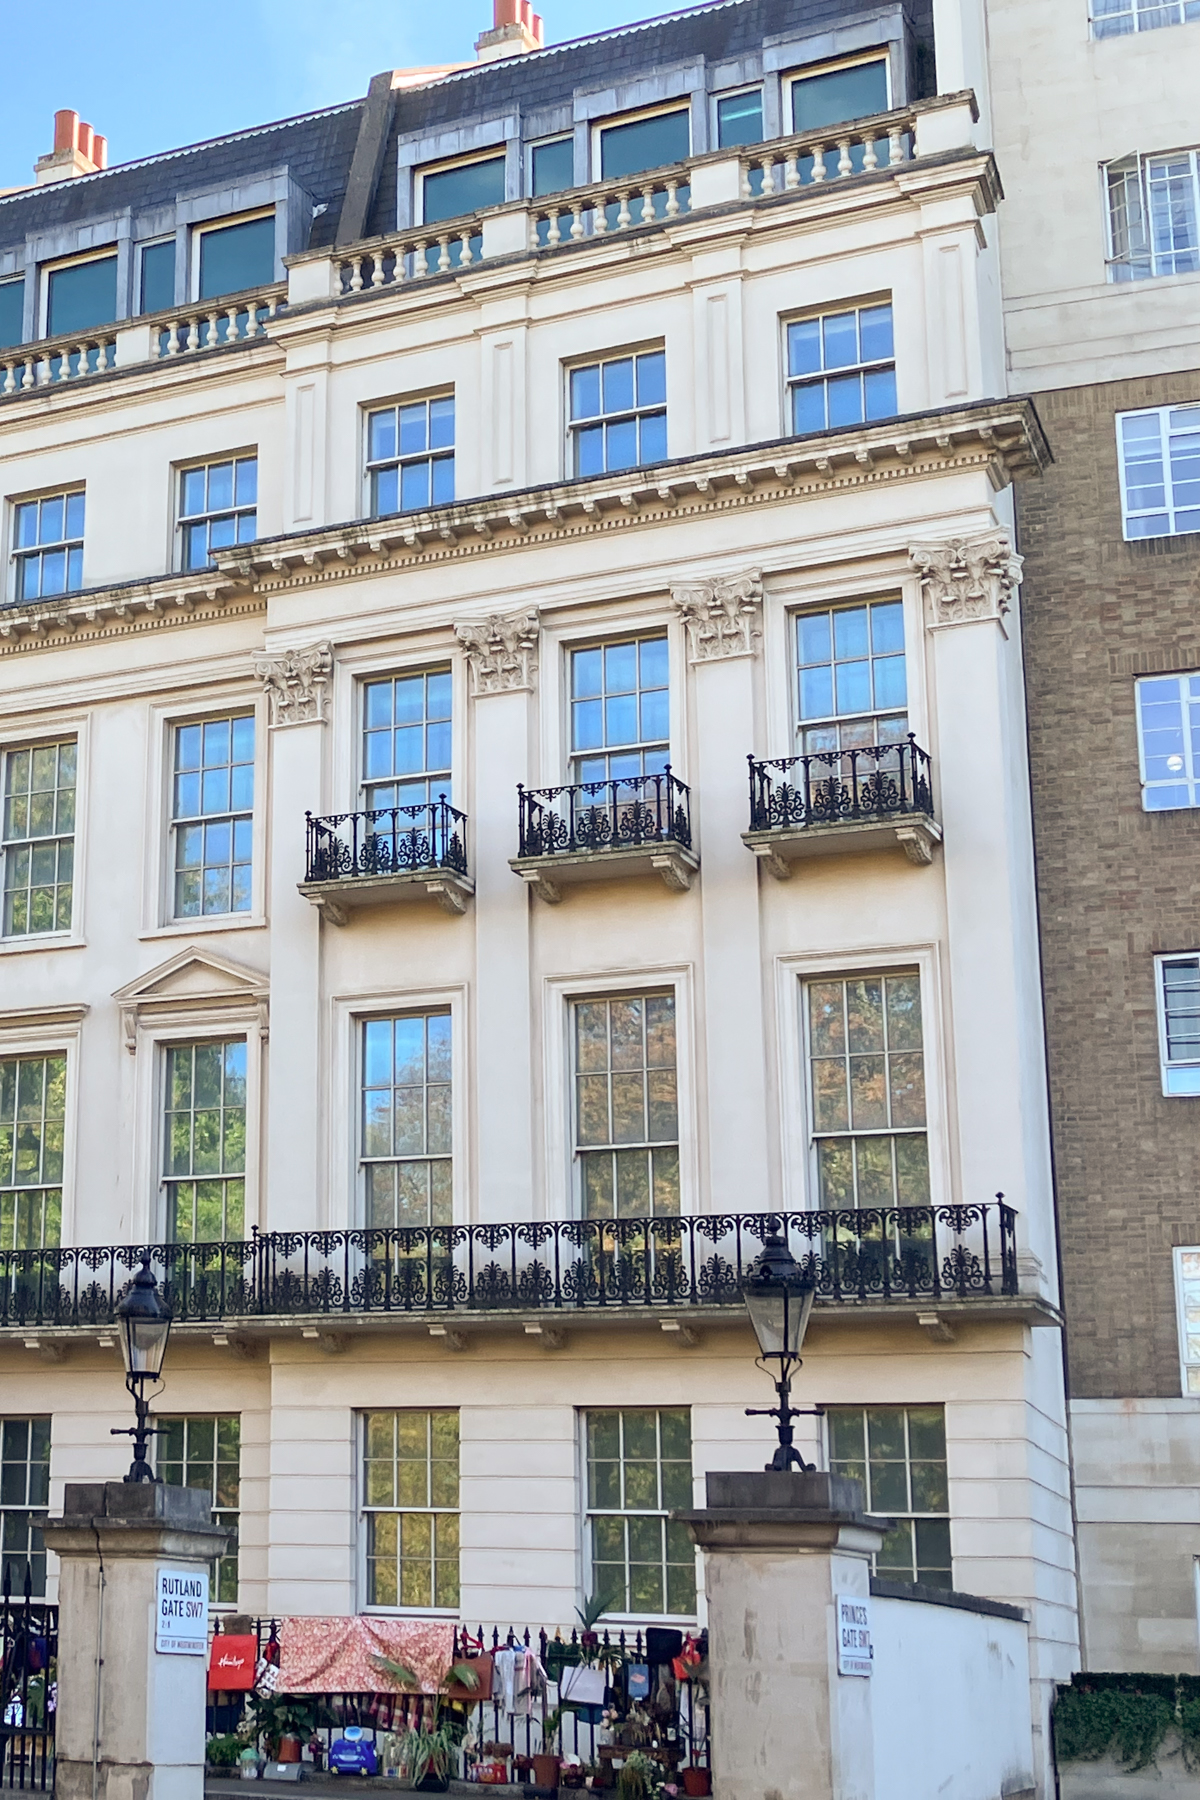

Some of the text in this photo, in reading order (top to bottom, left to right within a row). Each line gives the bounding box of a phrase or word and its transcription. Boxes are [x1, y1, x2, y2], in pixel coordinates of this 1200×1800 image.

[162, 1578, 202, 1597] RUTLAND
[162, 1599, 203, 1618] GATE SW7
[842, 1628, 857, 1648] GATE
